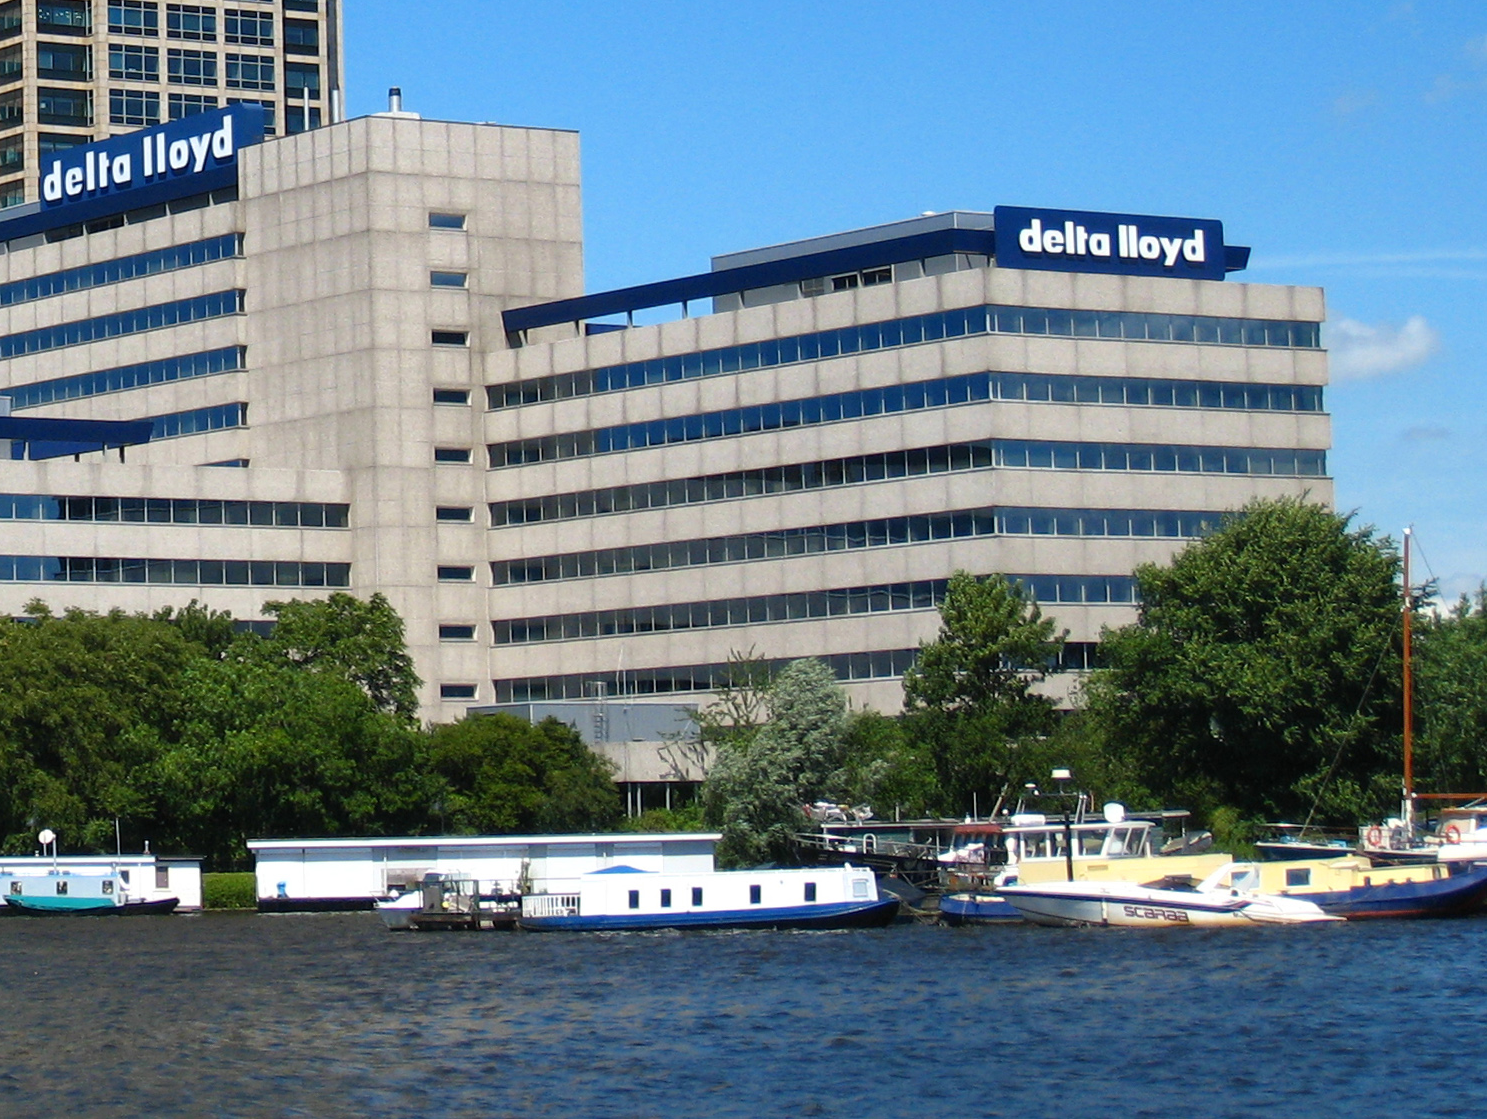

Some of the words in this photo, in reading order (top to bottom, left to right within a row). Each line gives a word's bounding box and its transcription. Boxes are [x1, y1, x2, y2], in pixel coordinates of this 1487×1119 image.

[43, 150, 132, 202] delta
[143, 114, 233, 174] lloyd
[1019, 218, 1111, 258] delta
[1118, 224, 1205, 267] lloyd
